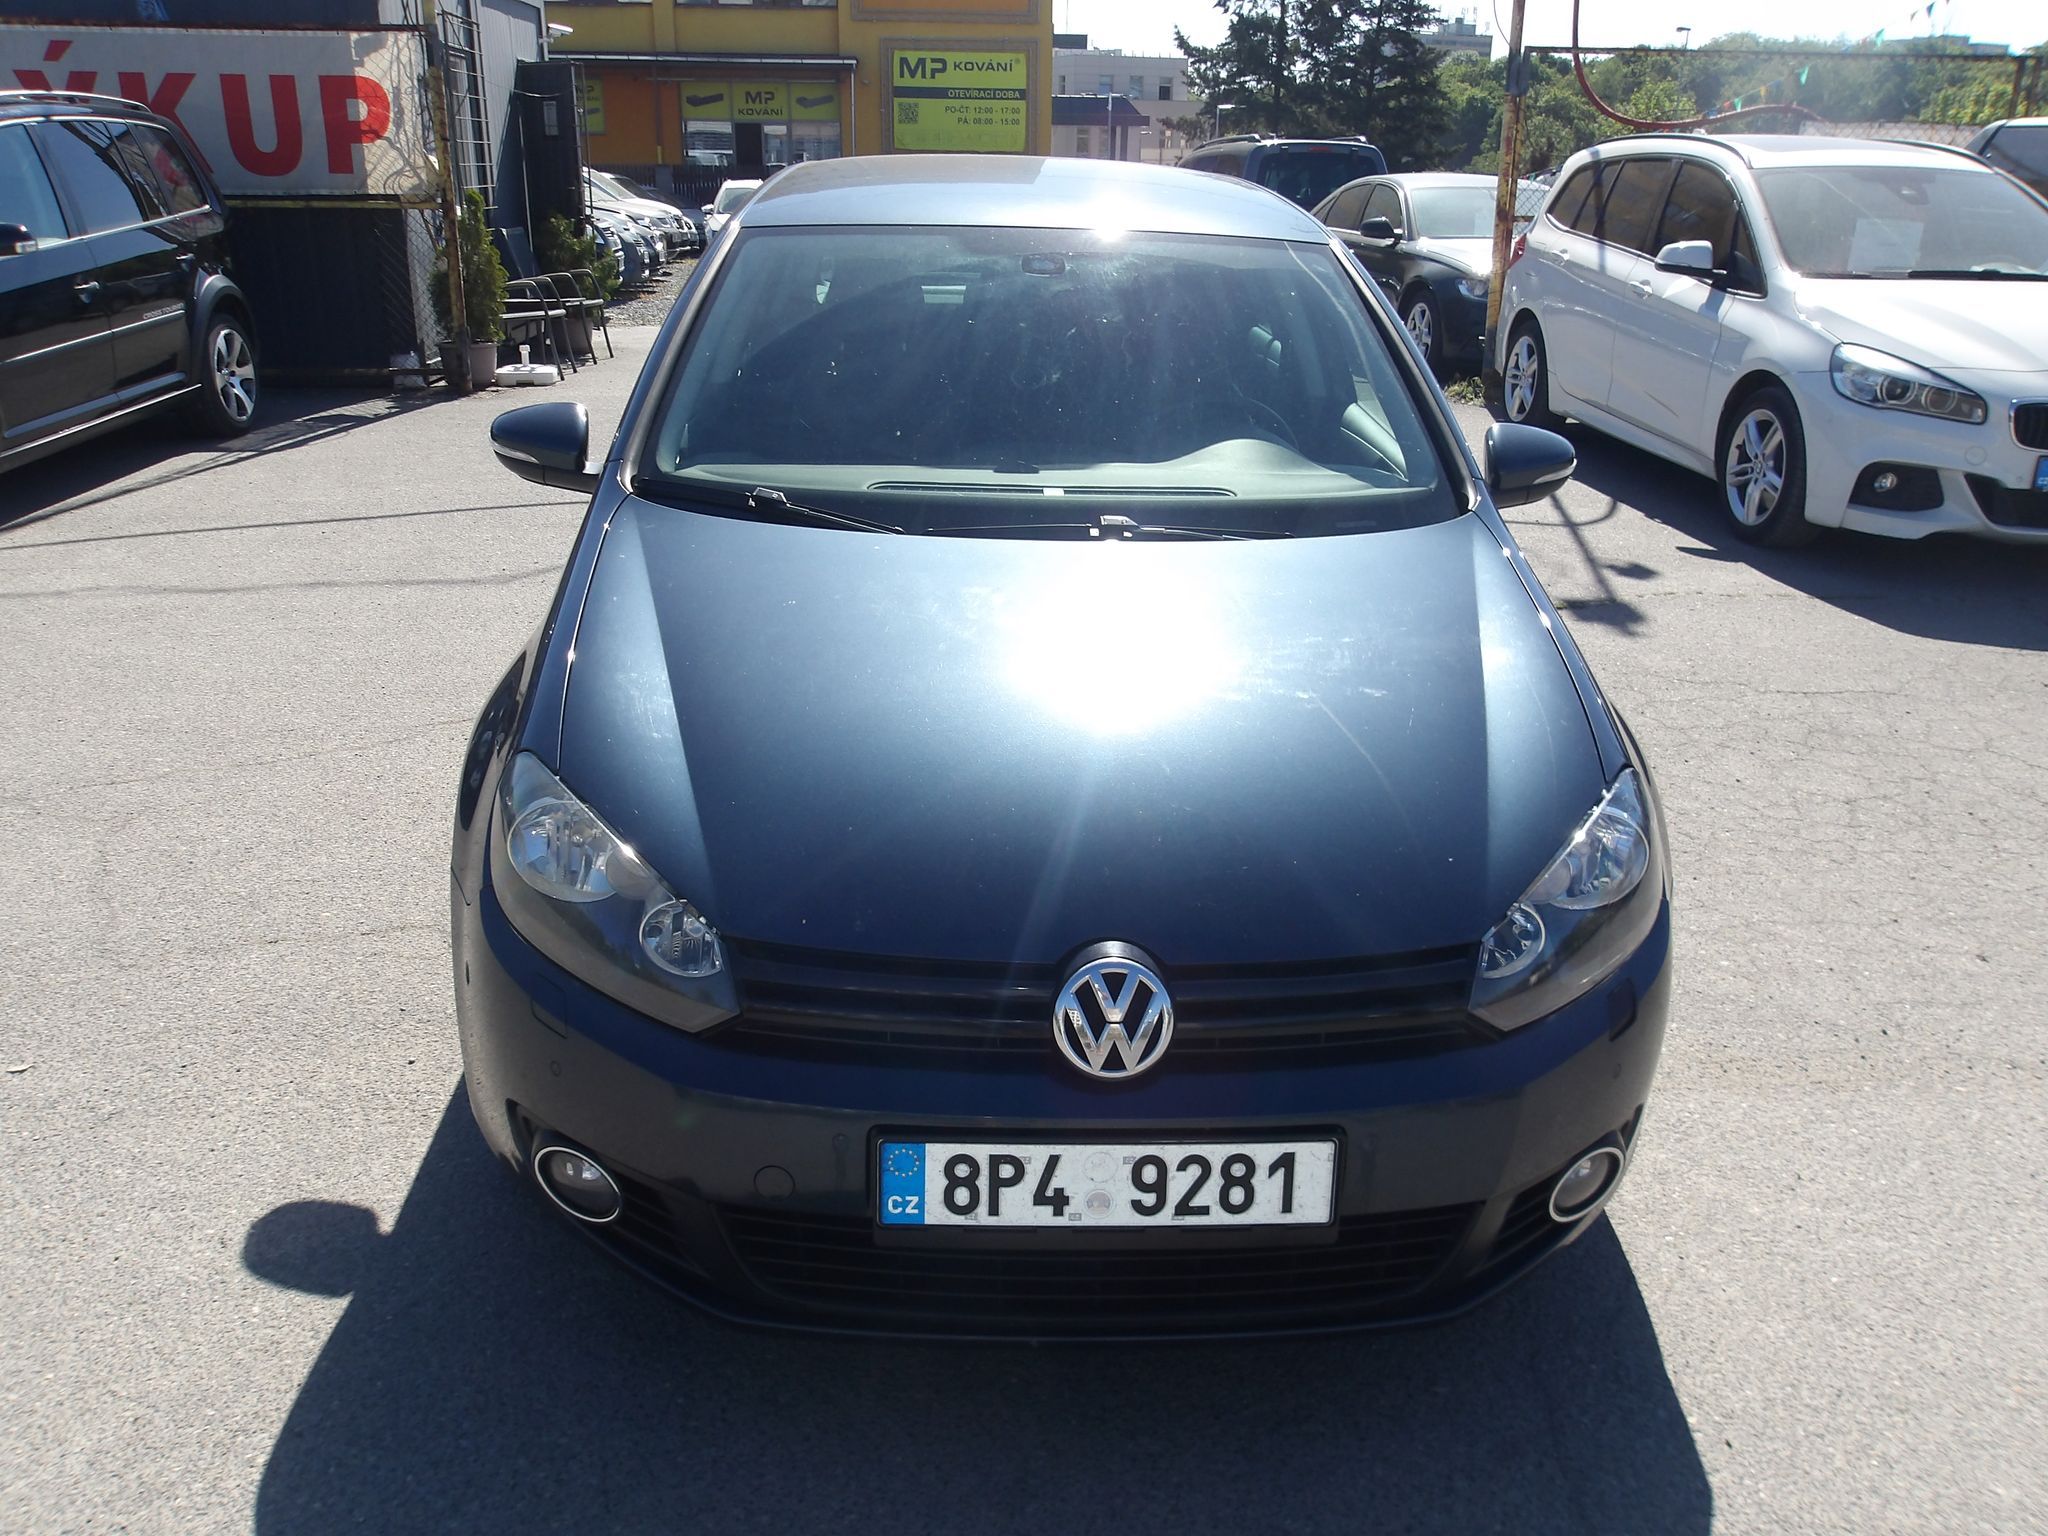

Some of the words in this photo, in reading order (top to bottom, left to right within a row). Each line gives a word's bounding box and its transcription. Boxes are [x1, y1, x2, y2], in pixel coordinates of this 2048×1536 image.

[899, 56, 948, 79] MP
[953, 59, 1013, 72] KOVÁNÍ
[745, 91, 775, 104] MP
[947, 88, 994, 98] OTEVÍRACÍ
[995, 90, 1020, 99] DOBA
[973, 106, 993, 114] 12:00
[1000, 107, 1020, 115] 17:00
[1000, 117, 1020, 125] 15:00
[943, 1153, 1070, 1217] 8P4
[1130, 1151, 1297, 1217] 9281
[887, 1195, 919, 1214] CZ
